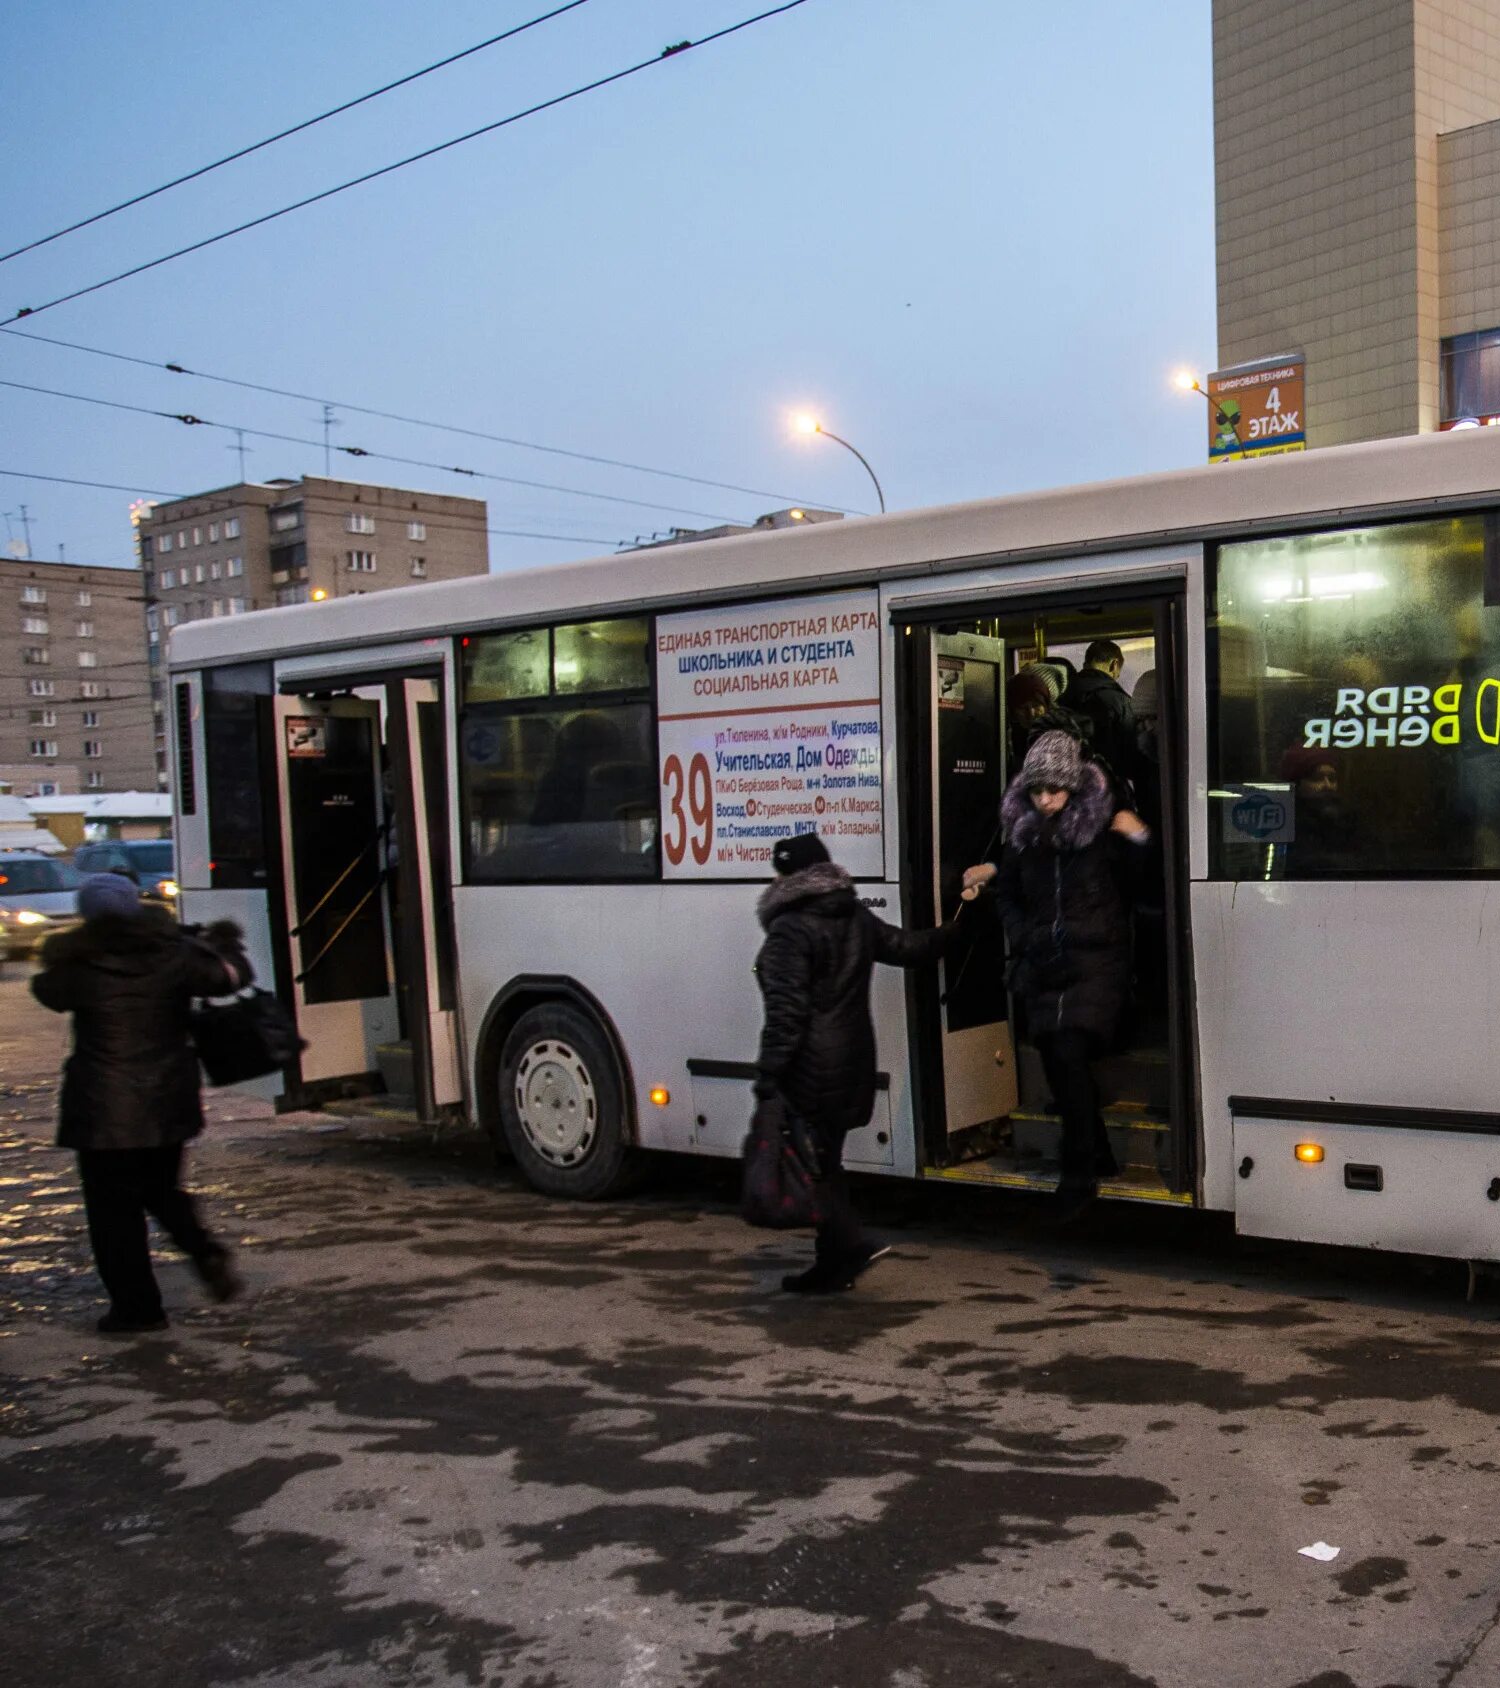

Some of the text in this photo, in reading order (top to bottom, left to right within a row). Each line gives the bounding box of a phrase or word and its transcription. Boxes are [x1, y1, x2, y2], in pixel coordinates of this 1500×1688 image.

[1217, 368, 1295, 391] ЦИФРОВАЯ ТЕХНИКА
[1265, 386, 1281, 413] 4
[1248, 411, 1299, 438] ЭТАЖ
[658, 612, 878, 654] ЕДИНАЯ ТРАНСПОРТНАЯ КАРТА
[678, 639, 855, 674] ШКОЛЬНИКА И СТУДЕНТА
[693, 666, 839, 698] СОЦИАЛЬНАЯ КАРТА
[790, 722, 830, 741] Родники,
[796, 744, 822, 772] Дом
[806, 778, 821, 789] м-н
[823, 774, 856, 789] Золотая
[663, 752, 713, 866] 39
[735, 843, 772, 862] Чистая
